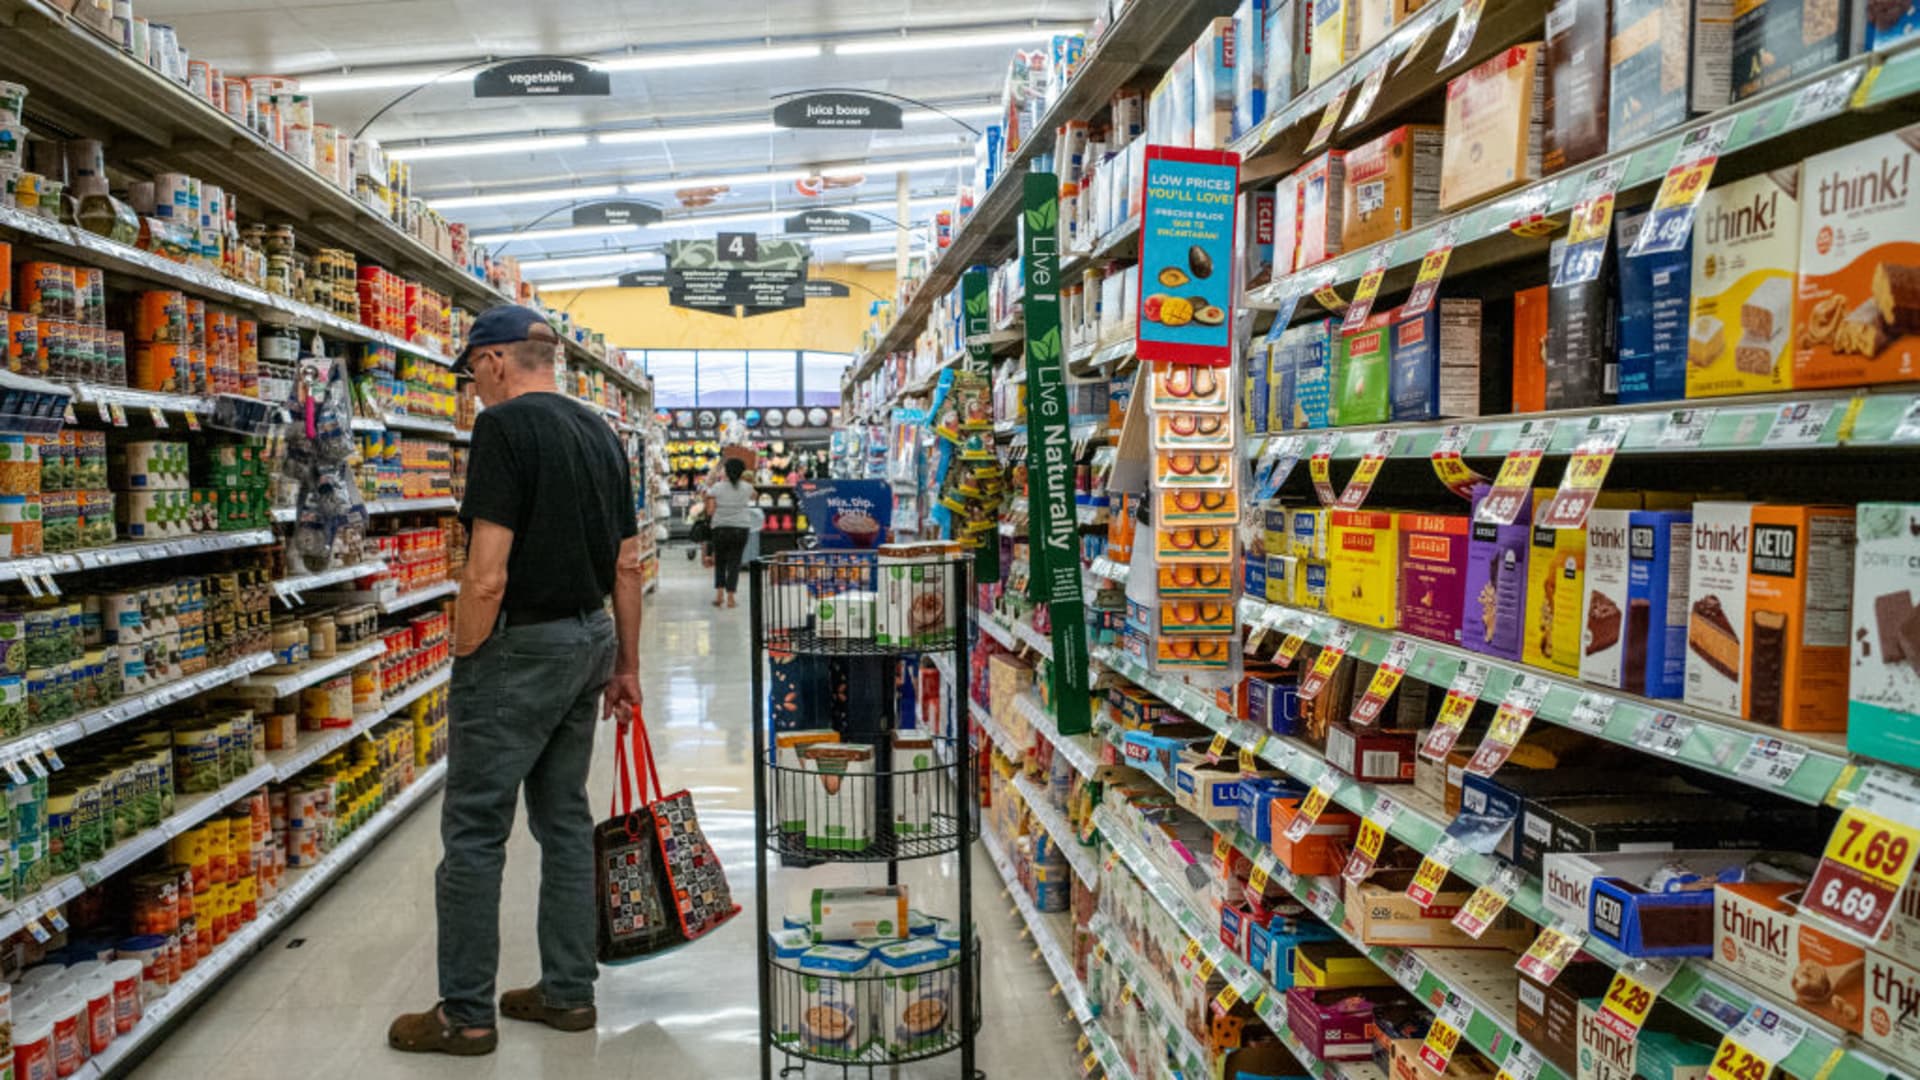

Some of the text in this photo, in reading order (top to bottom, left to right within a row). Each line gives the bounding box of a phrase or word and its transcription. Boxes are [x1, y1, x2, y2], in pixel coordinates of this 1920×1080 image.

[508, 70, 575, 86] vegetables
[806, 104, 870, 117] juice boxes
[1148, 187, 1233, 205] YOU'LL LOVE!
[1152, 175, 1231, 191] LOW PRICES
[1819, 153, 1910, 216] think!
[1706, 190, 1777, 245] think!
[728, 236, 746, 258] 4
[1032, 237, 1057, 286] Live
[1037, 366, 1061, 416] Live
[1044, 424, 1076, 550] Naturally
[1590, 527, 1625, 549] think!
[1695, 521, 1749, 553] think!
[1754, 528, 1794, 557] KETO
[1838, 819, 1910, 877] 7.69
[1547, 869, 1588, 909] think!
[1821, 878, 1876, 922] 6.69
[1722, 900, 1788, 958] think!
[1609, 977, 1651, 1016] 2.29
[1582, 1015, 1633, 1073] think!
[1716, 1043, 1766, 1080] 2.29
